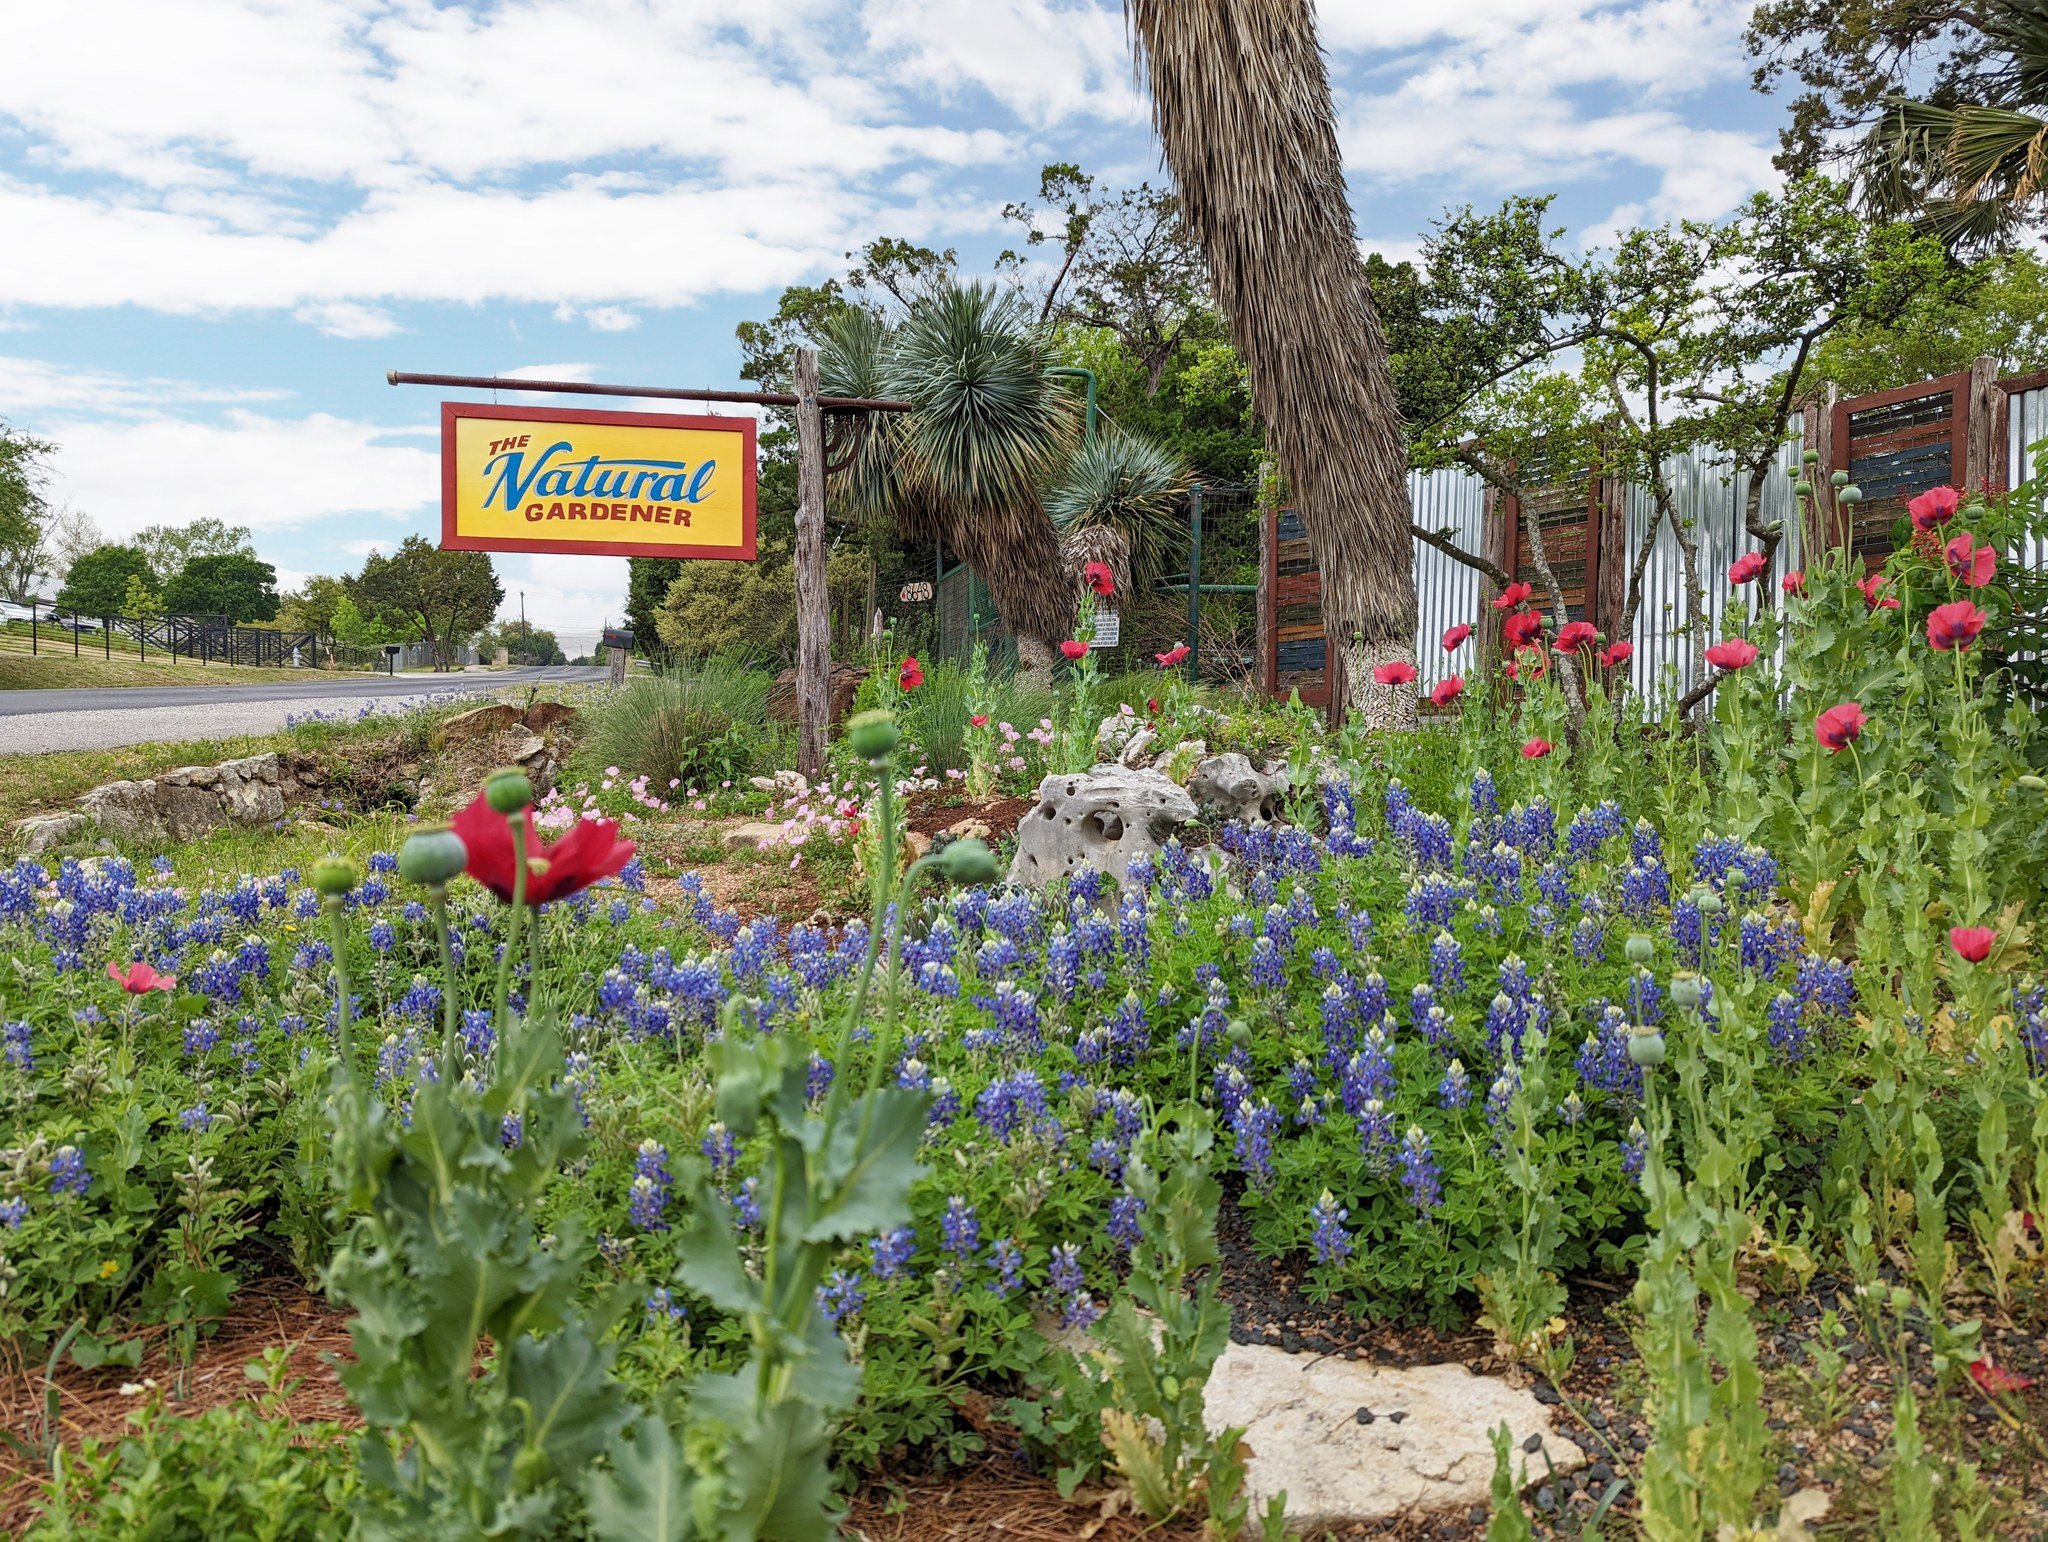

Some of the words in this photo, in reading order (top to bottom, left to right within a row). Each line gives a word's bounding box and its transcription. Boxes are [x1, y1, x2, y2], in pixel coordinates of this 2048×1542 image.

[489, 435, 531, 456] THE
[483, 441, 716, 512] Natural
[525, 502, 692, 528] GARDENER
[906, 582, 930, 601] 8648
